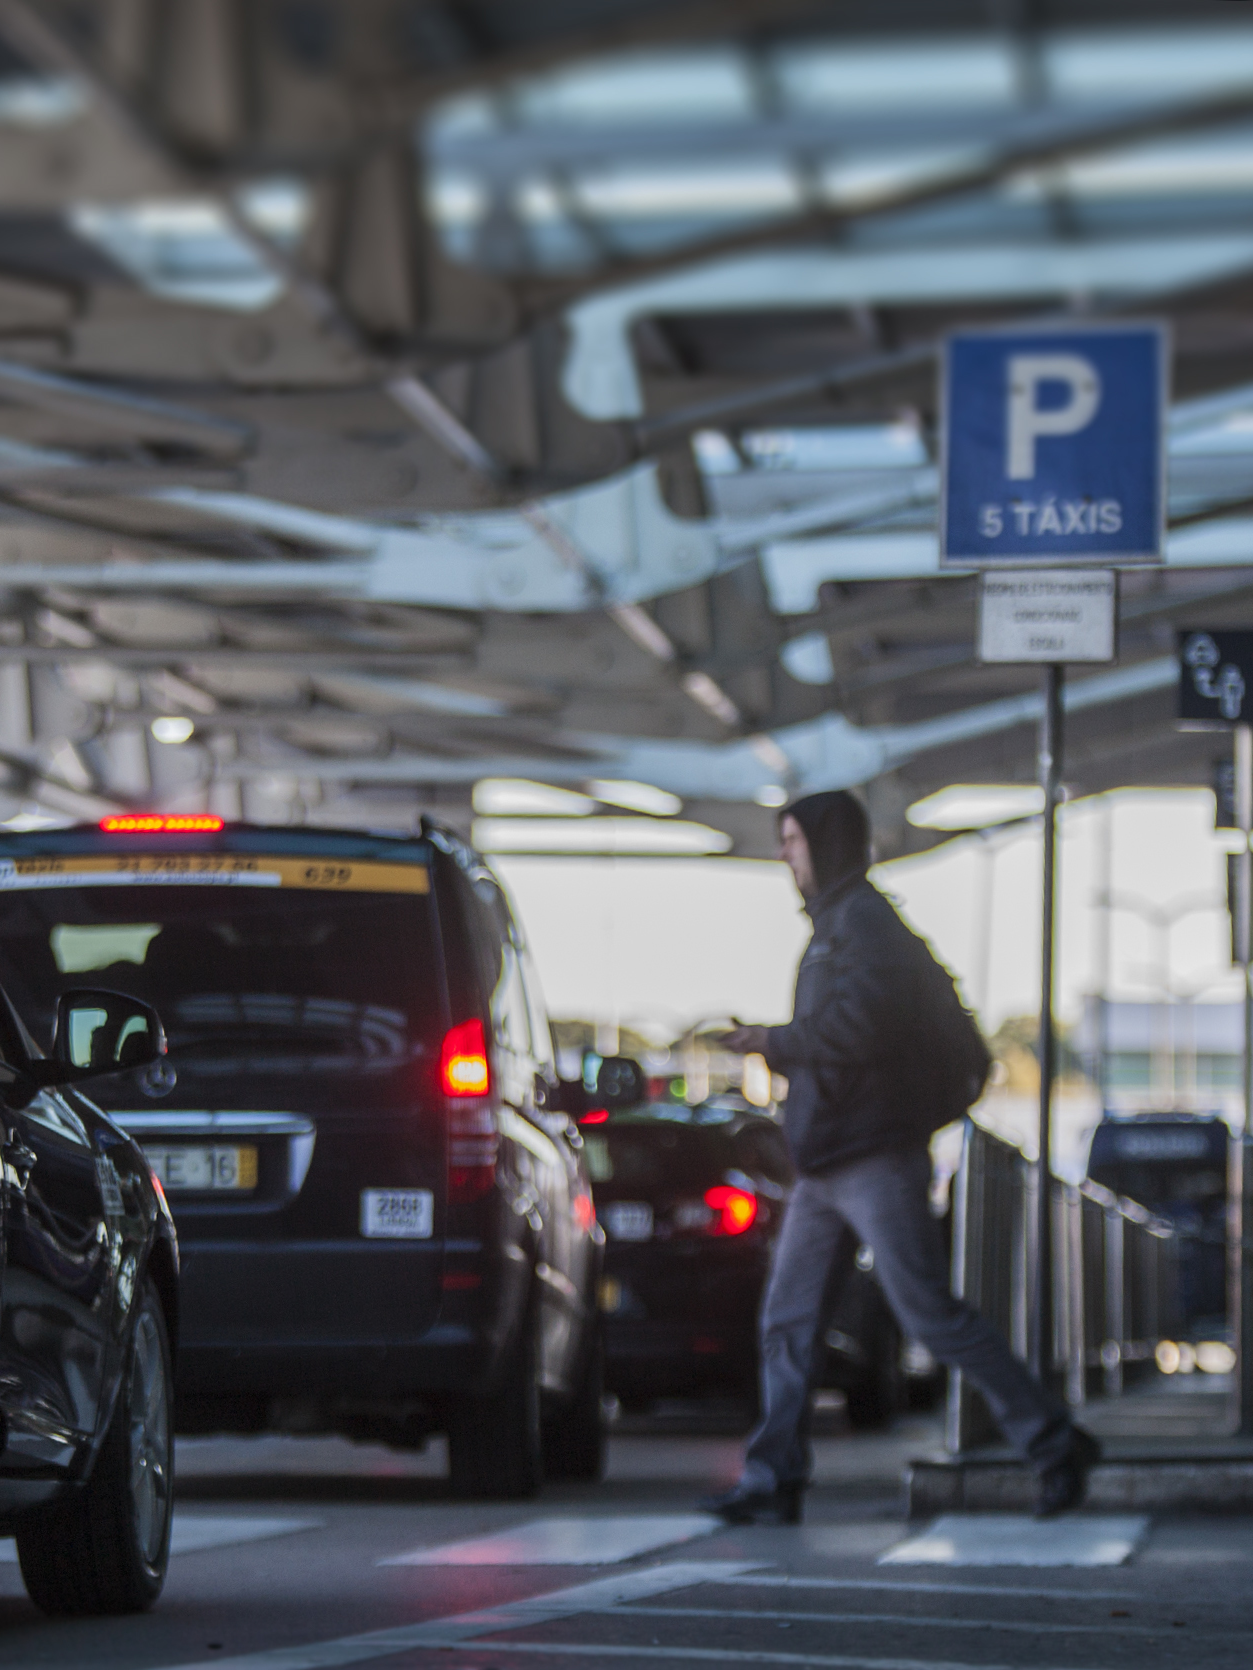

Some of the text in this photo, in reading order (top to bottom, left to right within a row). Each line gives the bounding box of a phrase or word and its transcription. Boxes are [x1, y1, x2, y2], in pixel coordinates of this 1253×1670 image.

[1005, 354, 1101, 481] P
[980, 496, 1123, 538] 5 TÁXIS
